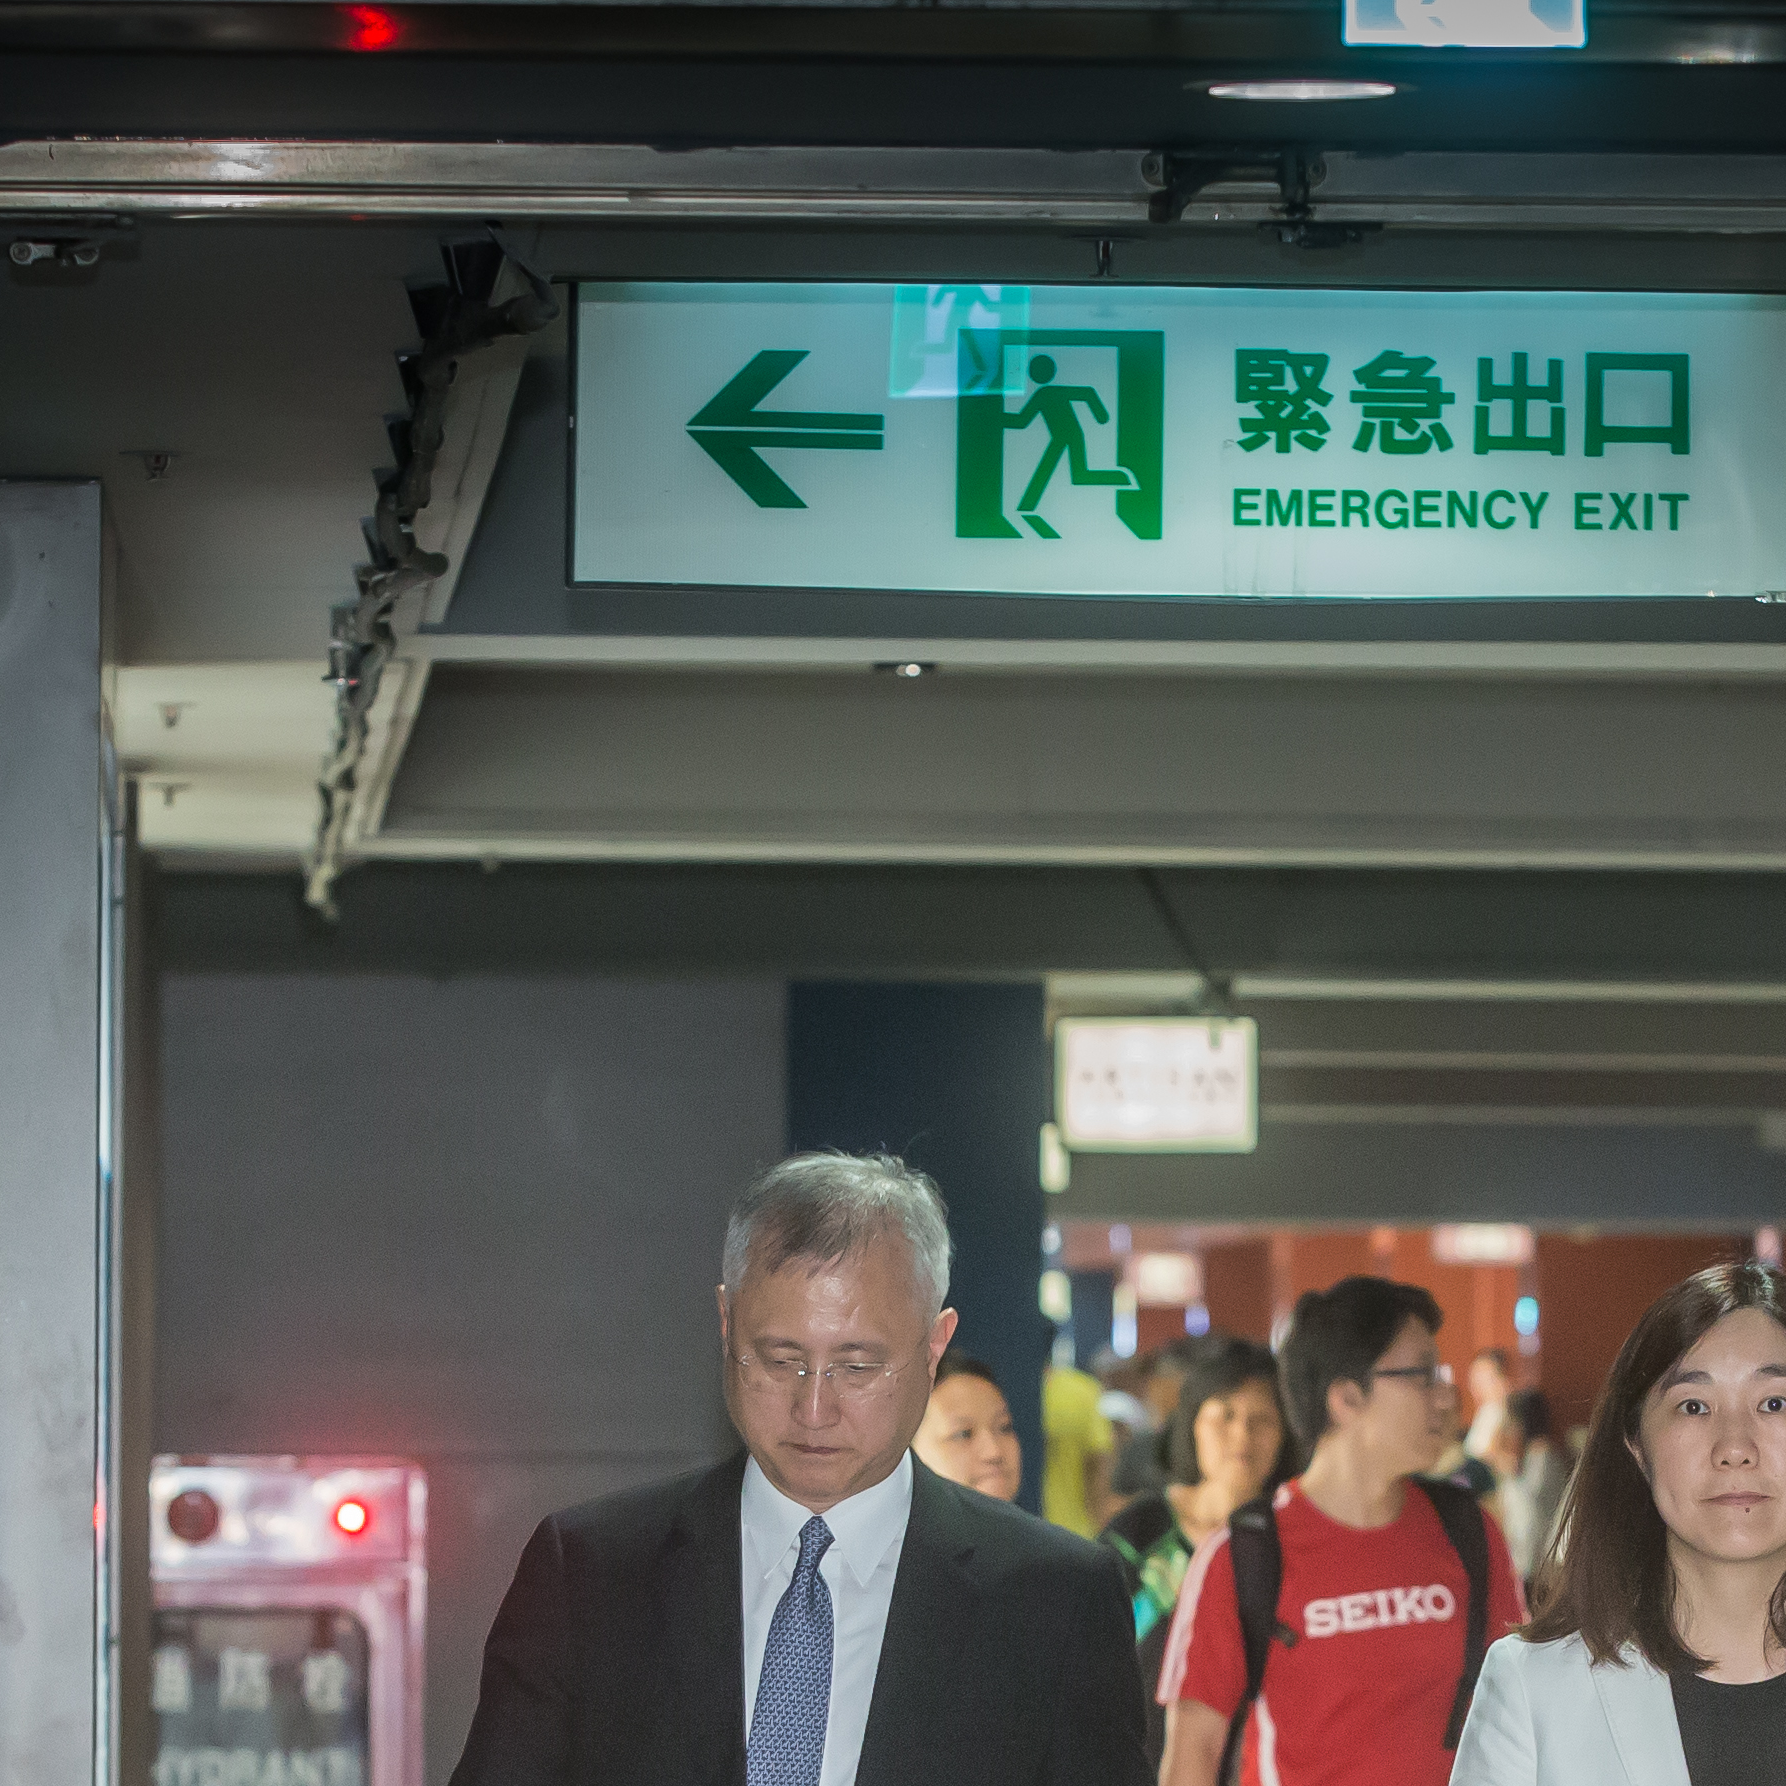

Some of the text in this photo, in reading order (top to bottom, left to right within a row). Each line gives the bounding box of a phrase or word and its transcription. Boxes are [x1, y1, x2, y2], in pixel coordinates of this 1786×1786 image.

[1234, 347, 1693, 458] 緊急出口
[1232, 487, 1691, 533] EMERGENCY EXIT
[1303, 1583, 1456, 1640] SEIKO
